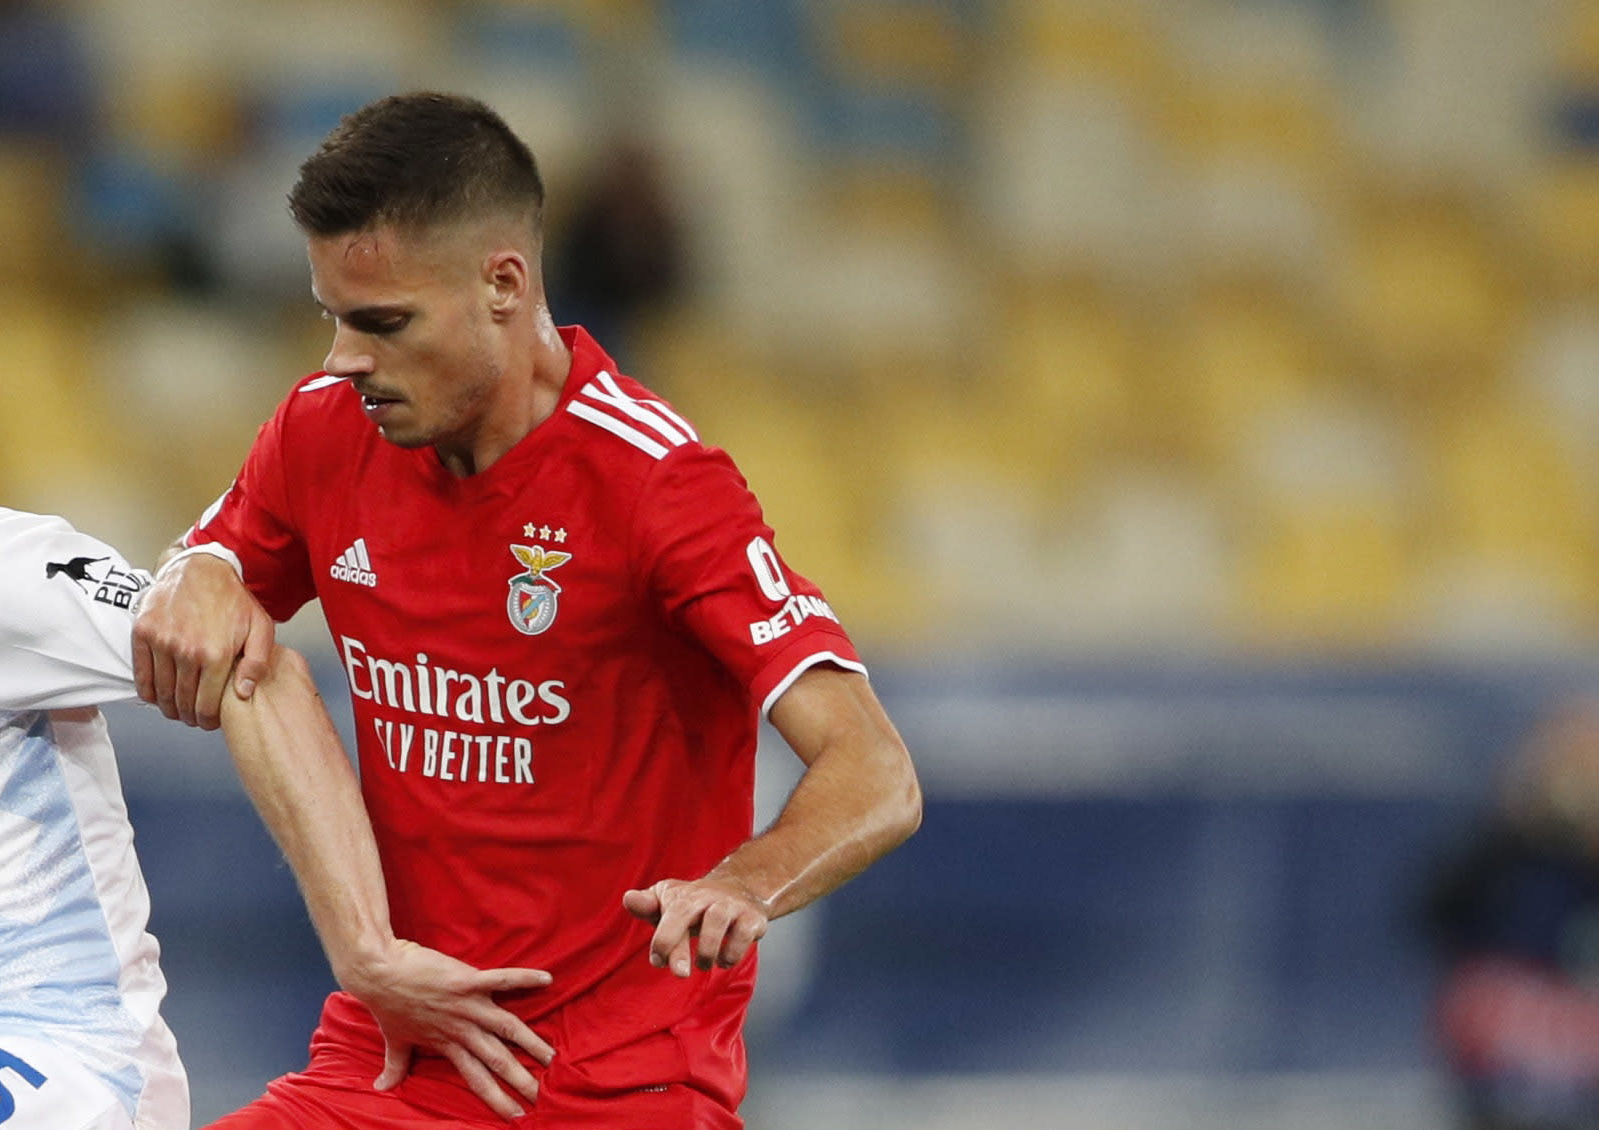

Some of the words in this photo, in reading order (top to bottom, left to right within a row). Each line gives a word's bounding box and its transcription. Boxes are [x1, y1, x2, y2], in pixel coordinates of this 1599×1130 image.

[94, 565, 126, 605] PIT
[113, 573, 151, 610] BU
[330, 564, 377, 587] adidas
[341, 635, 572, 726] Emirates
[423, 728, 535, 784] BETTER
